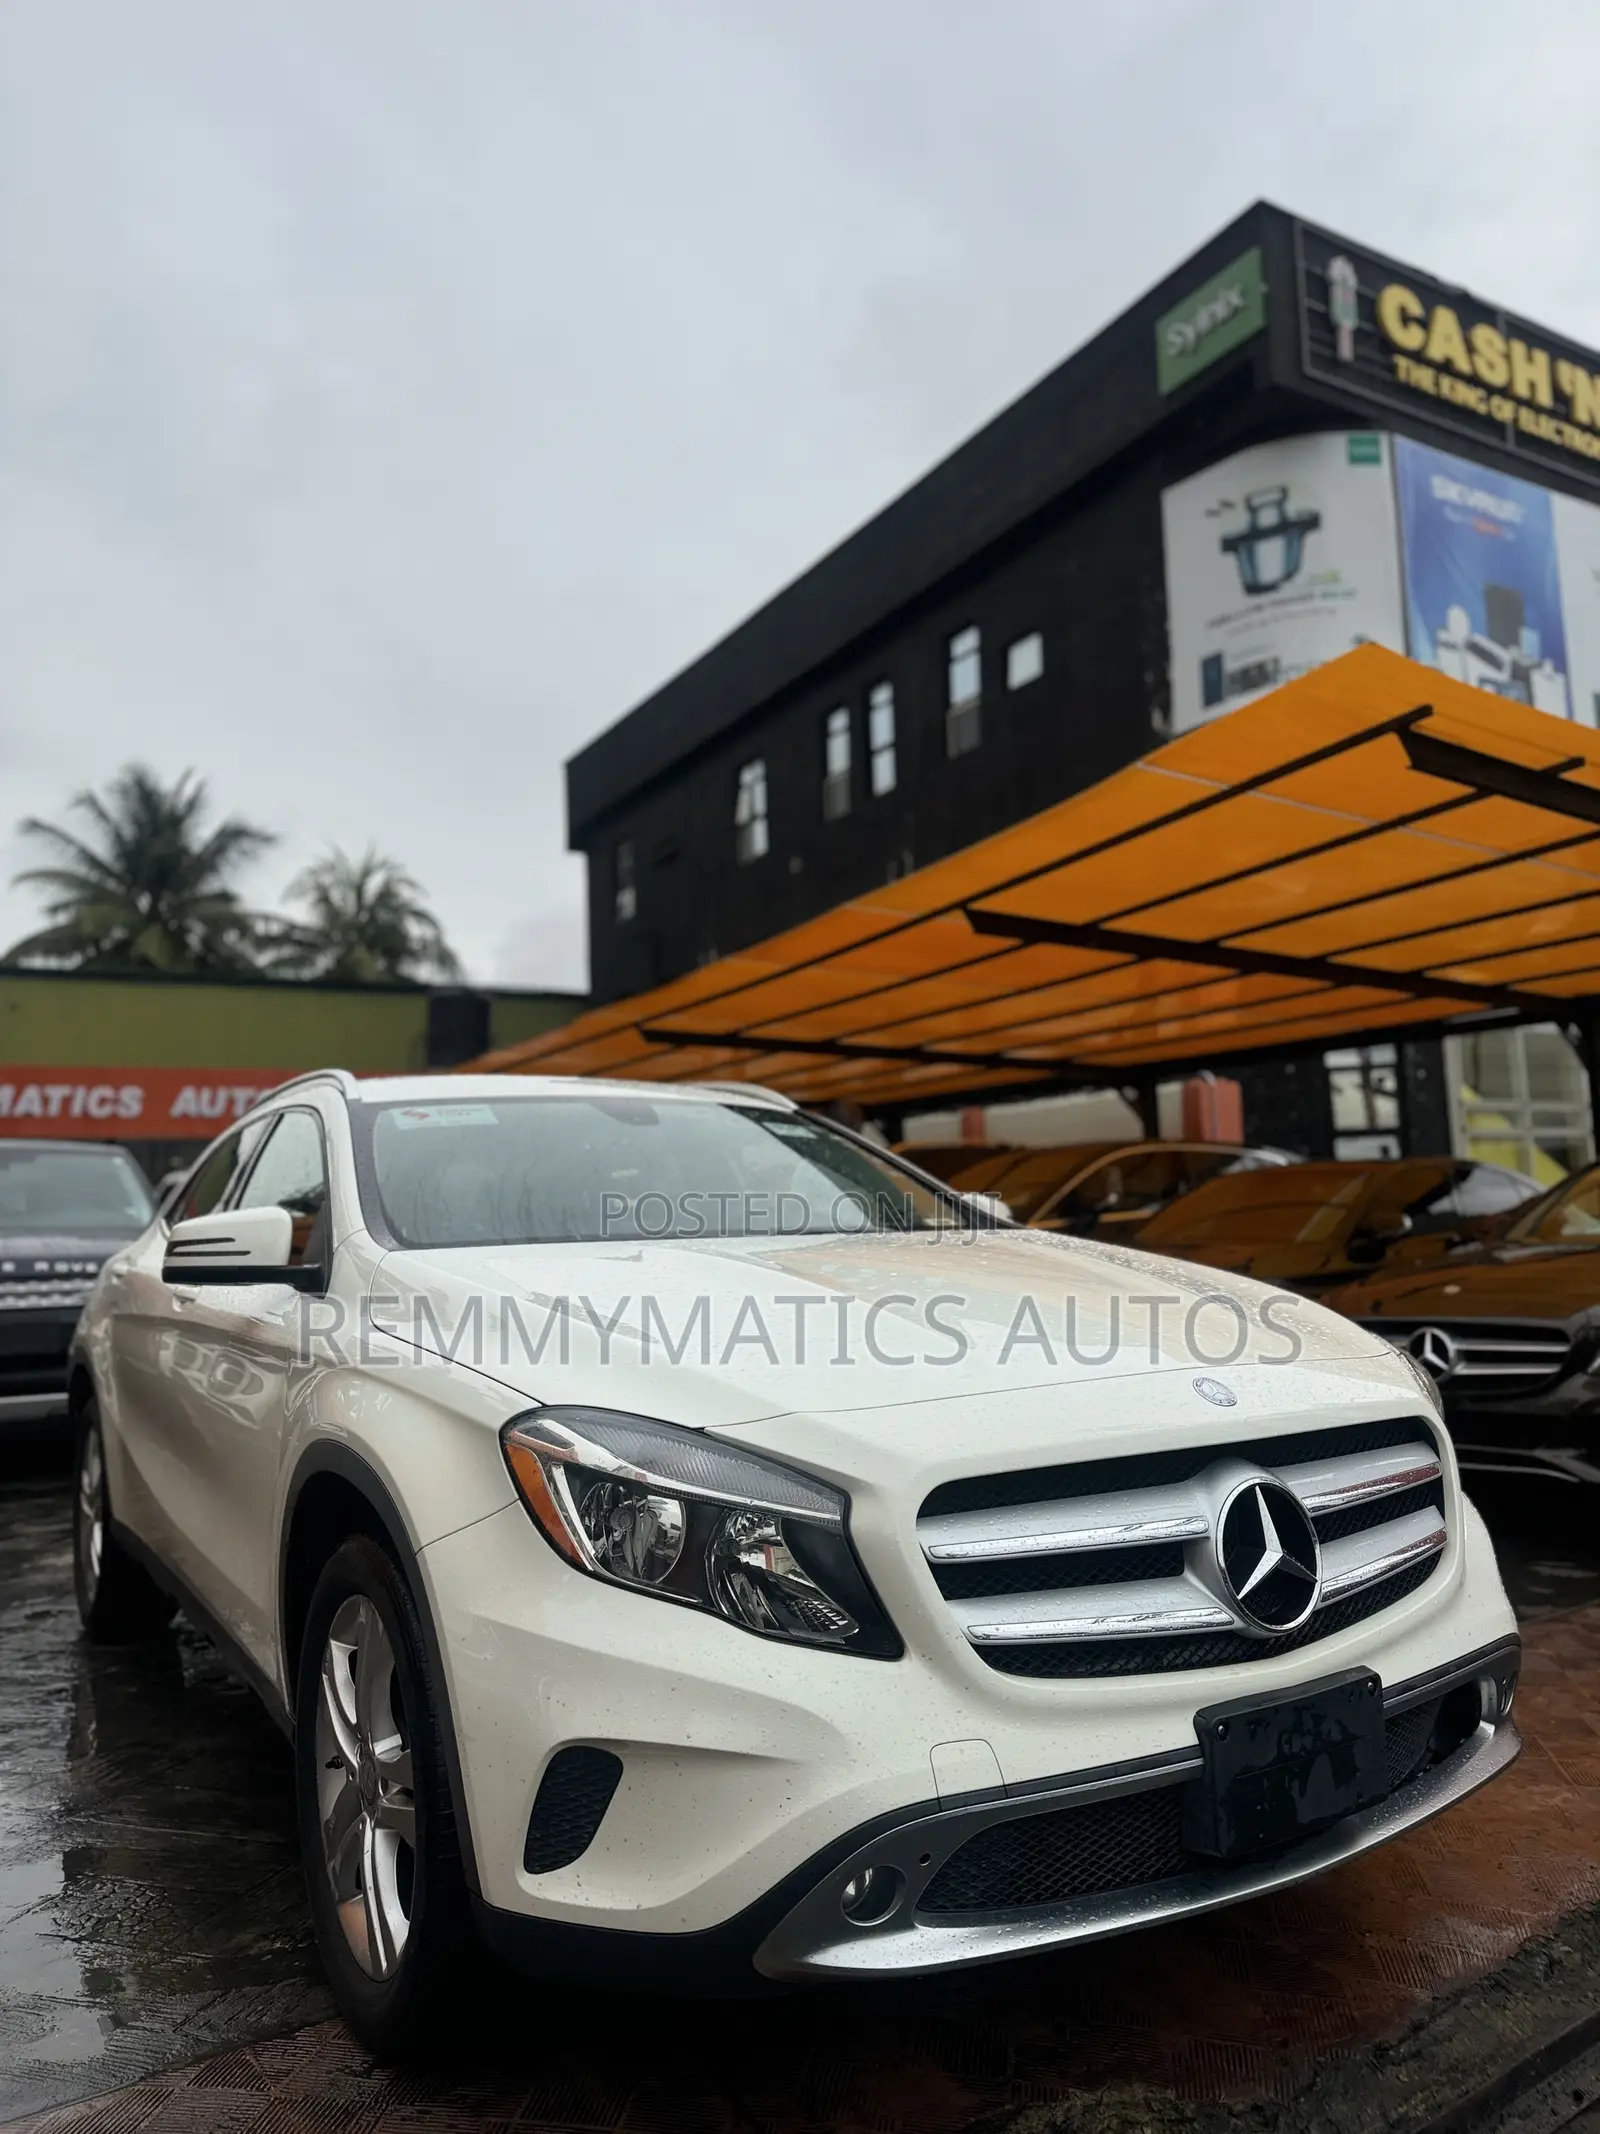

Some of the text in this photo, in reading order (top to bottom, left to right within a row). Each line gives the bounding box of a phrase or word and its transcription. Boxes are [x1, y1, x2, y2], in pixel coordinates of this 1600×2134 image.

[1377, 283, 1554, 409] CASH
[1393, 353, 1438, 395] THE
[1438, 372, 1489, 416] KING
[1489, 394, 1518, 423] OF
